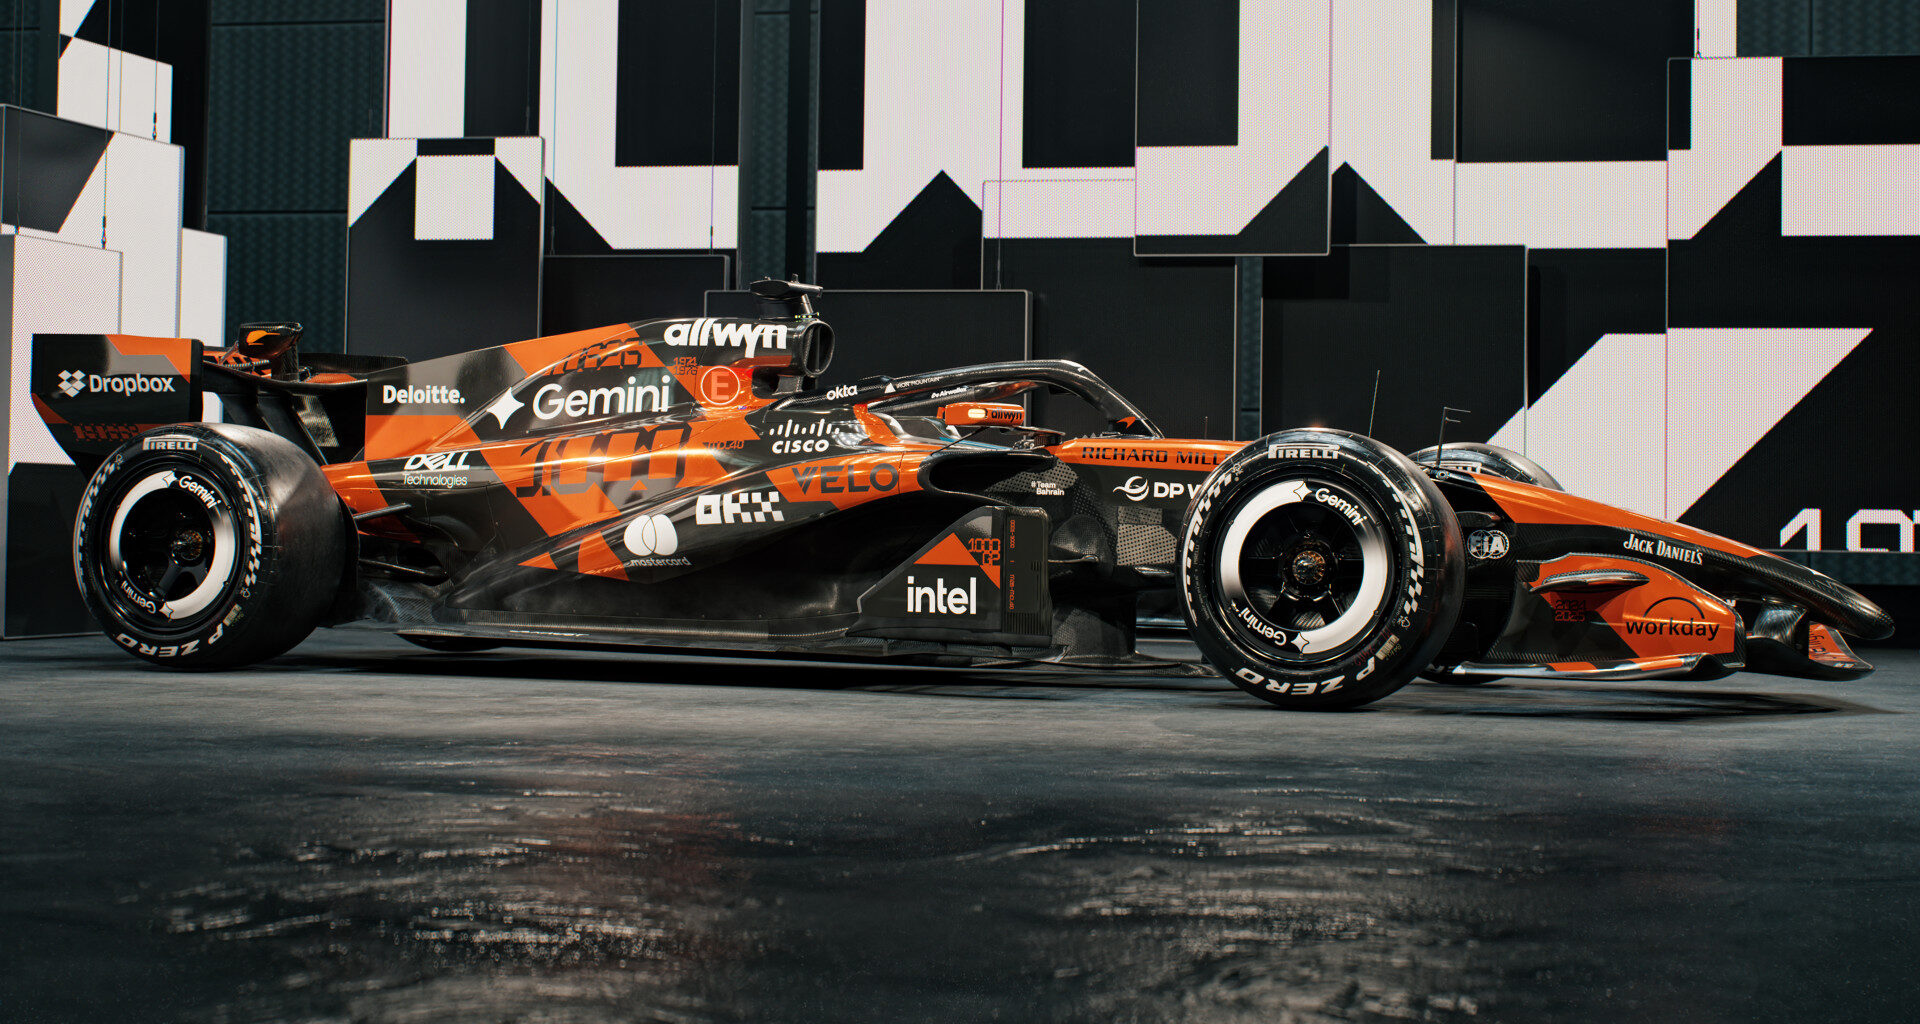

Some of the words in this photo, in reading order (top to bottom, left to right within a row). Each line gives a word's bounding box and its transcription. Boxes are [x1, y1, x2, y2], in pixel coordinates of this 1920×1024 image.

[664, 318, 787, 358] allwyn
[89, 374, 176, 396] Dropbox
[383, 385, 466, 404] Deloitte.
[711, 371, 730, 400] E
[826, 385, 858, 400] okta
[532, 375, 671, 420] Gemini
[991, 407, 1022, 422] allwyn
[143, 434, 199, 450] PIRELLI
[1268, 443, 1340, 459] PIRELLI
[404, 452, 470, 471] DELL
[1082, 446, 1168, 463] RICHARD
[1176, 451, 1231, 465] MILL
[402, 473, 468, 488] Technologies
[792, 463, 899, 495] VELO
[1154, 482, 1184, 498] DP
[179, 475, 221, 509] Gemini
[1036, 487, 1065, 496] Bahrain
[696, 491, 785, 525] OKX
[1315, 487, 1367, 526] Gemini
[630, 557, 693, 567] mastercard
[120, 581, 157, 614] Gemini
[907, 575, 977, 615] intel
[207, 623, 224, 645] P
[1239, 606, 1287, 647] Gemini
[1626, 617, 1720, 641] workday
[116, 633, 199, 658] ZERO
[1355, 656, 1376, 680] P
[1235, 667, 1346, 695] ZERO
